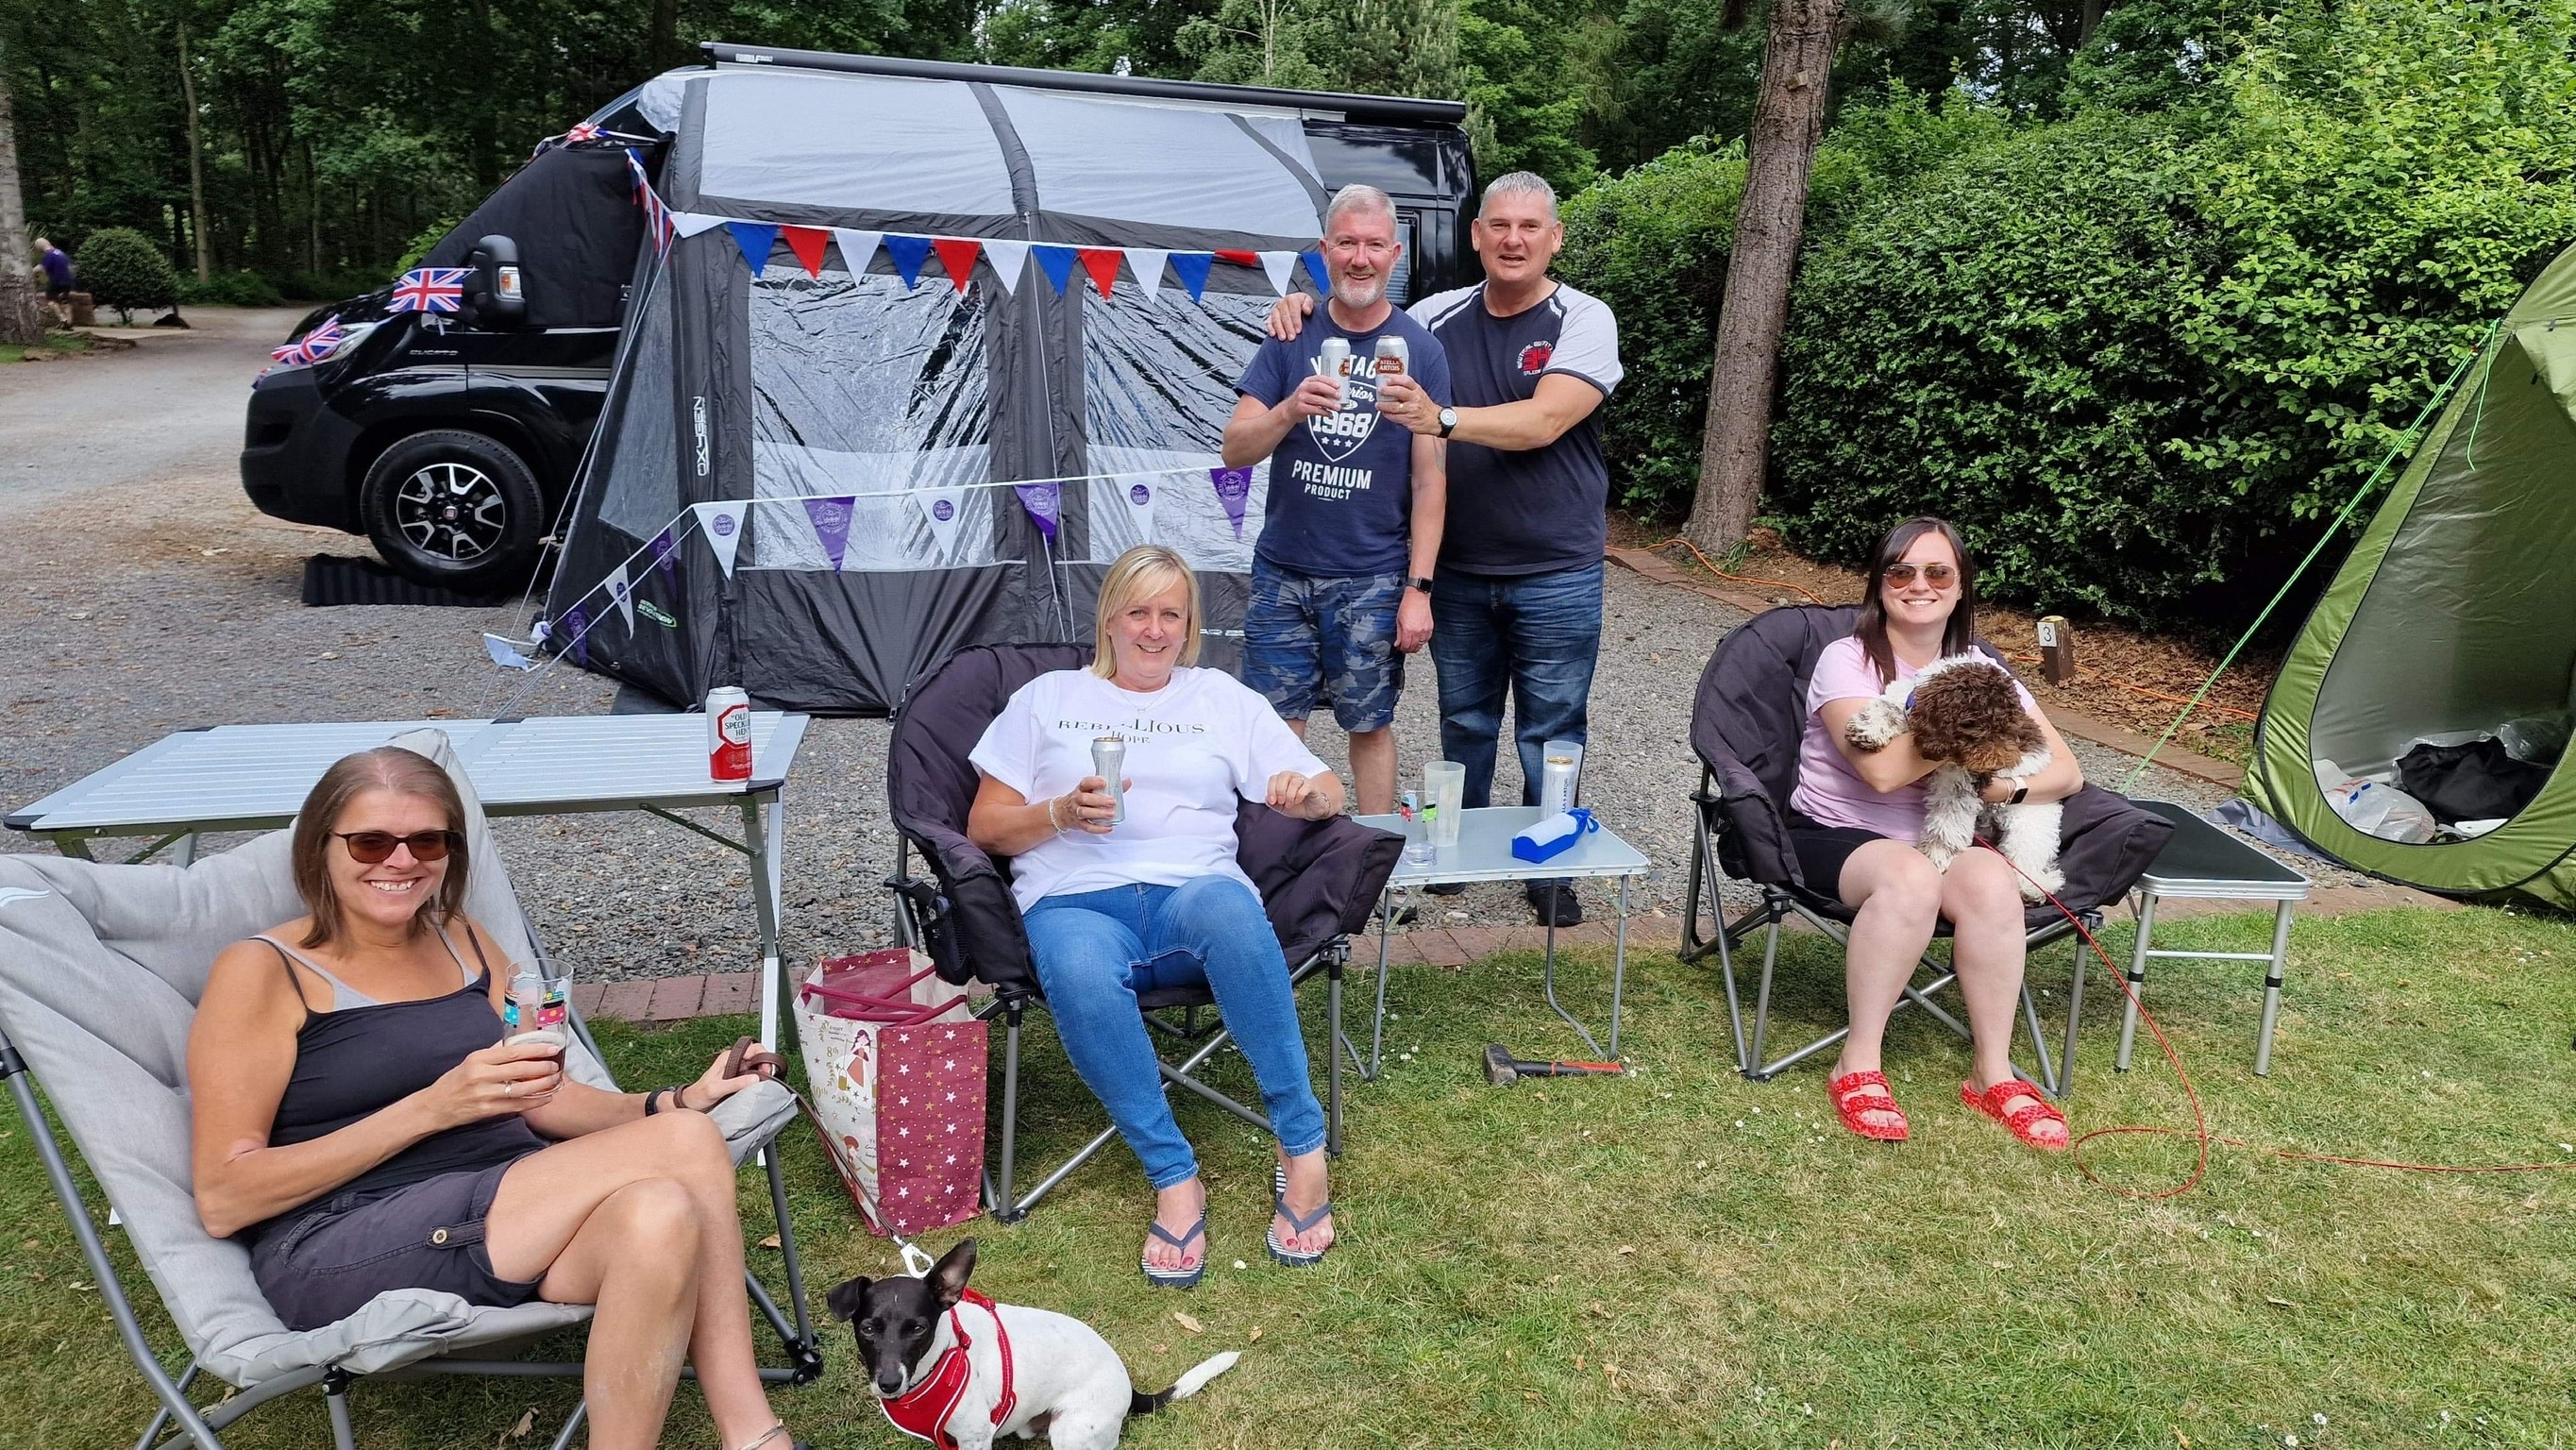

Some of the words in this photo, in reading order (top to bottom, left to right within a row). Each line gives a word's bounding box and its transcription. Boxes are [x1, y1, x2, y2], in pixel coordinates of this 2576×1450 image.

[1309, 354, 1376, 379] VTAG
[1313, 410, 1372, 438] 1968
[1291, 459, 1372, 490] PREMIUM
[1304, 483, 1351, 500] PRODUCT
[2043, 626, 2052, 642] 3
[1111, 731, 1151, 744] HOPE
[826, 1045, 839, 1058] 8th
